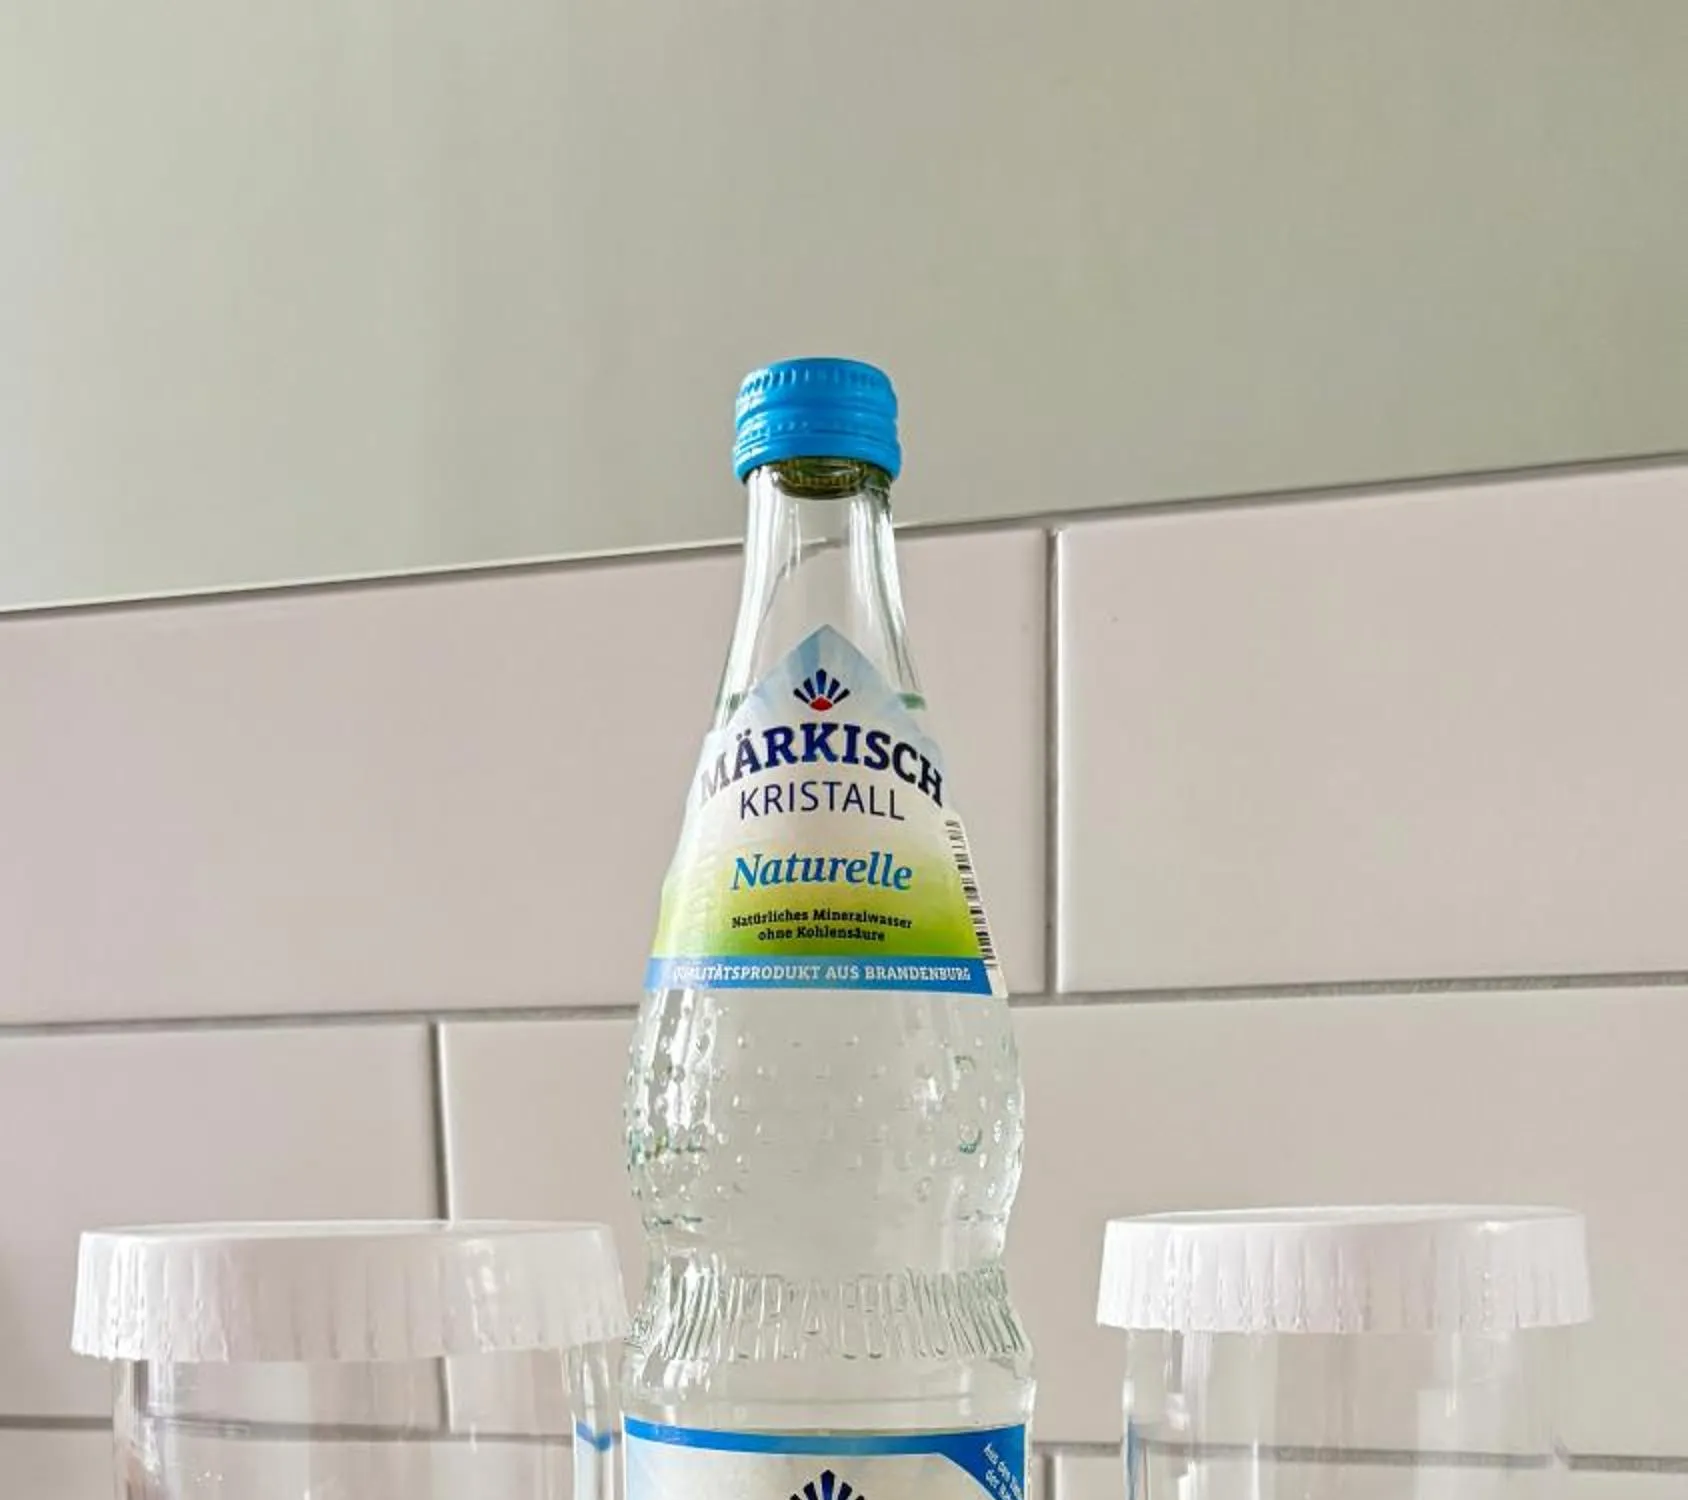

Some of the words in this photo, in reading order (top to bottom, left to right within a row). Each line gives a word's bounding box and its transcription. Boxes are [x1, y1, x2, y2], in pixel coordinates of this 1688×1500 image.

[701, 722, 943, 808] MÄRKISCH
[740, 781, 905, 821] KRISTALL
[732, 851, 913, 891] Naturelle
[731, 909, 809, 928] Natürliches
[812, 908, 913, 930] Mineralwasser
[758, 929, 793, 942] ohne
[796, 926, 886, 941] Kohlensäure
[825, 965, 860, 980] AUS
